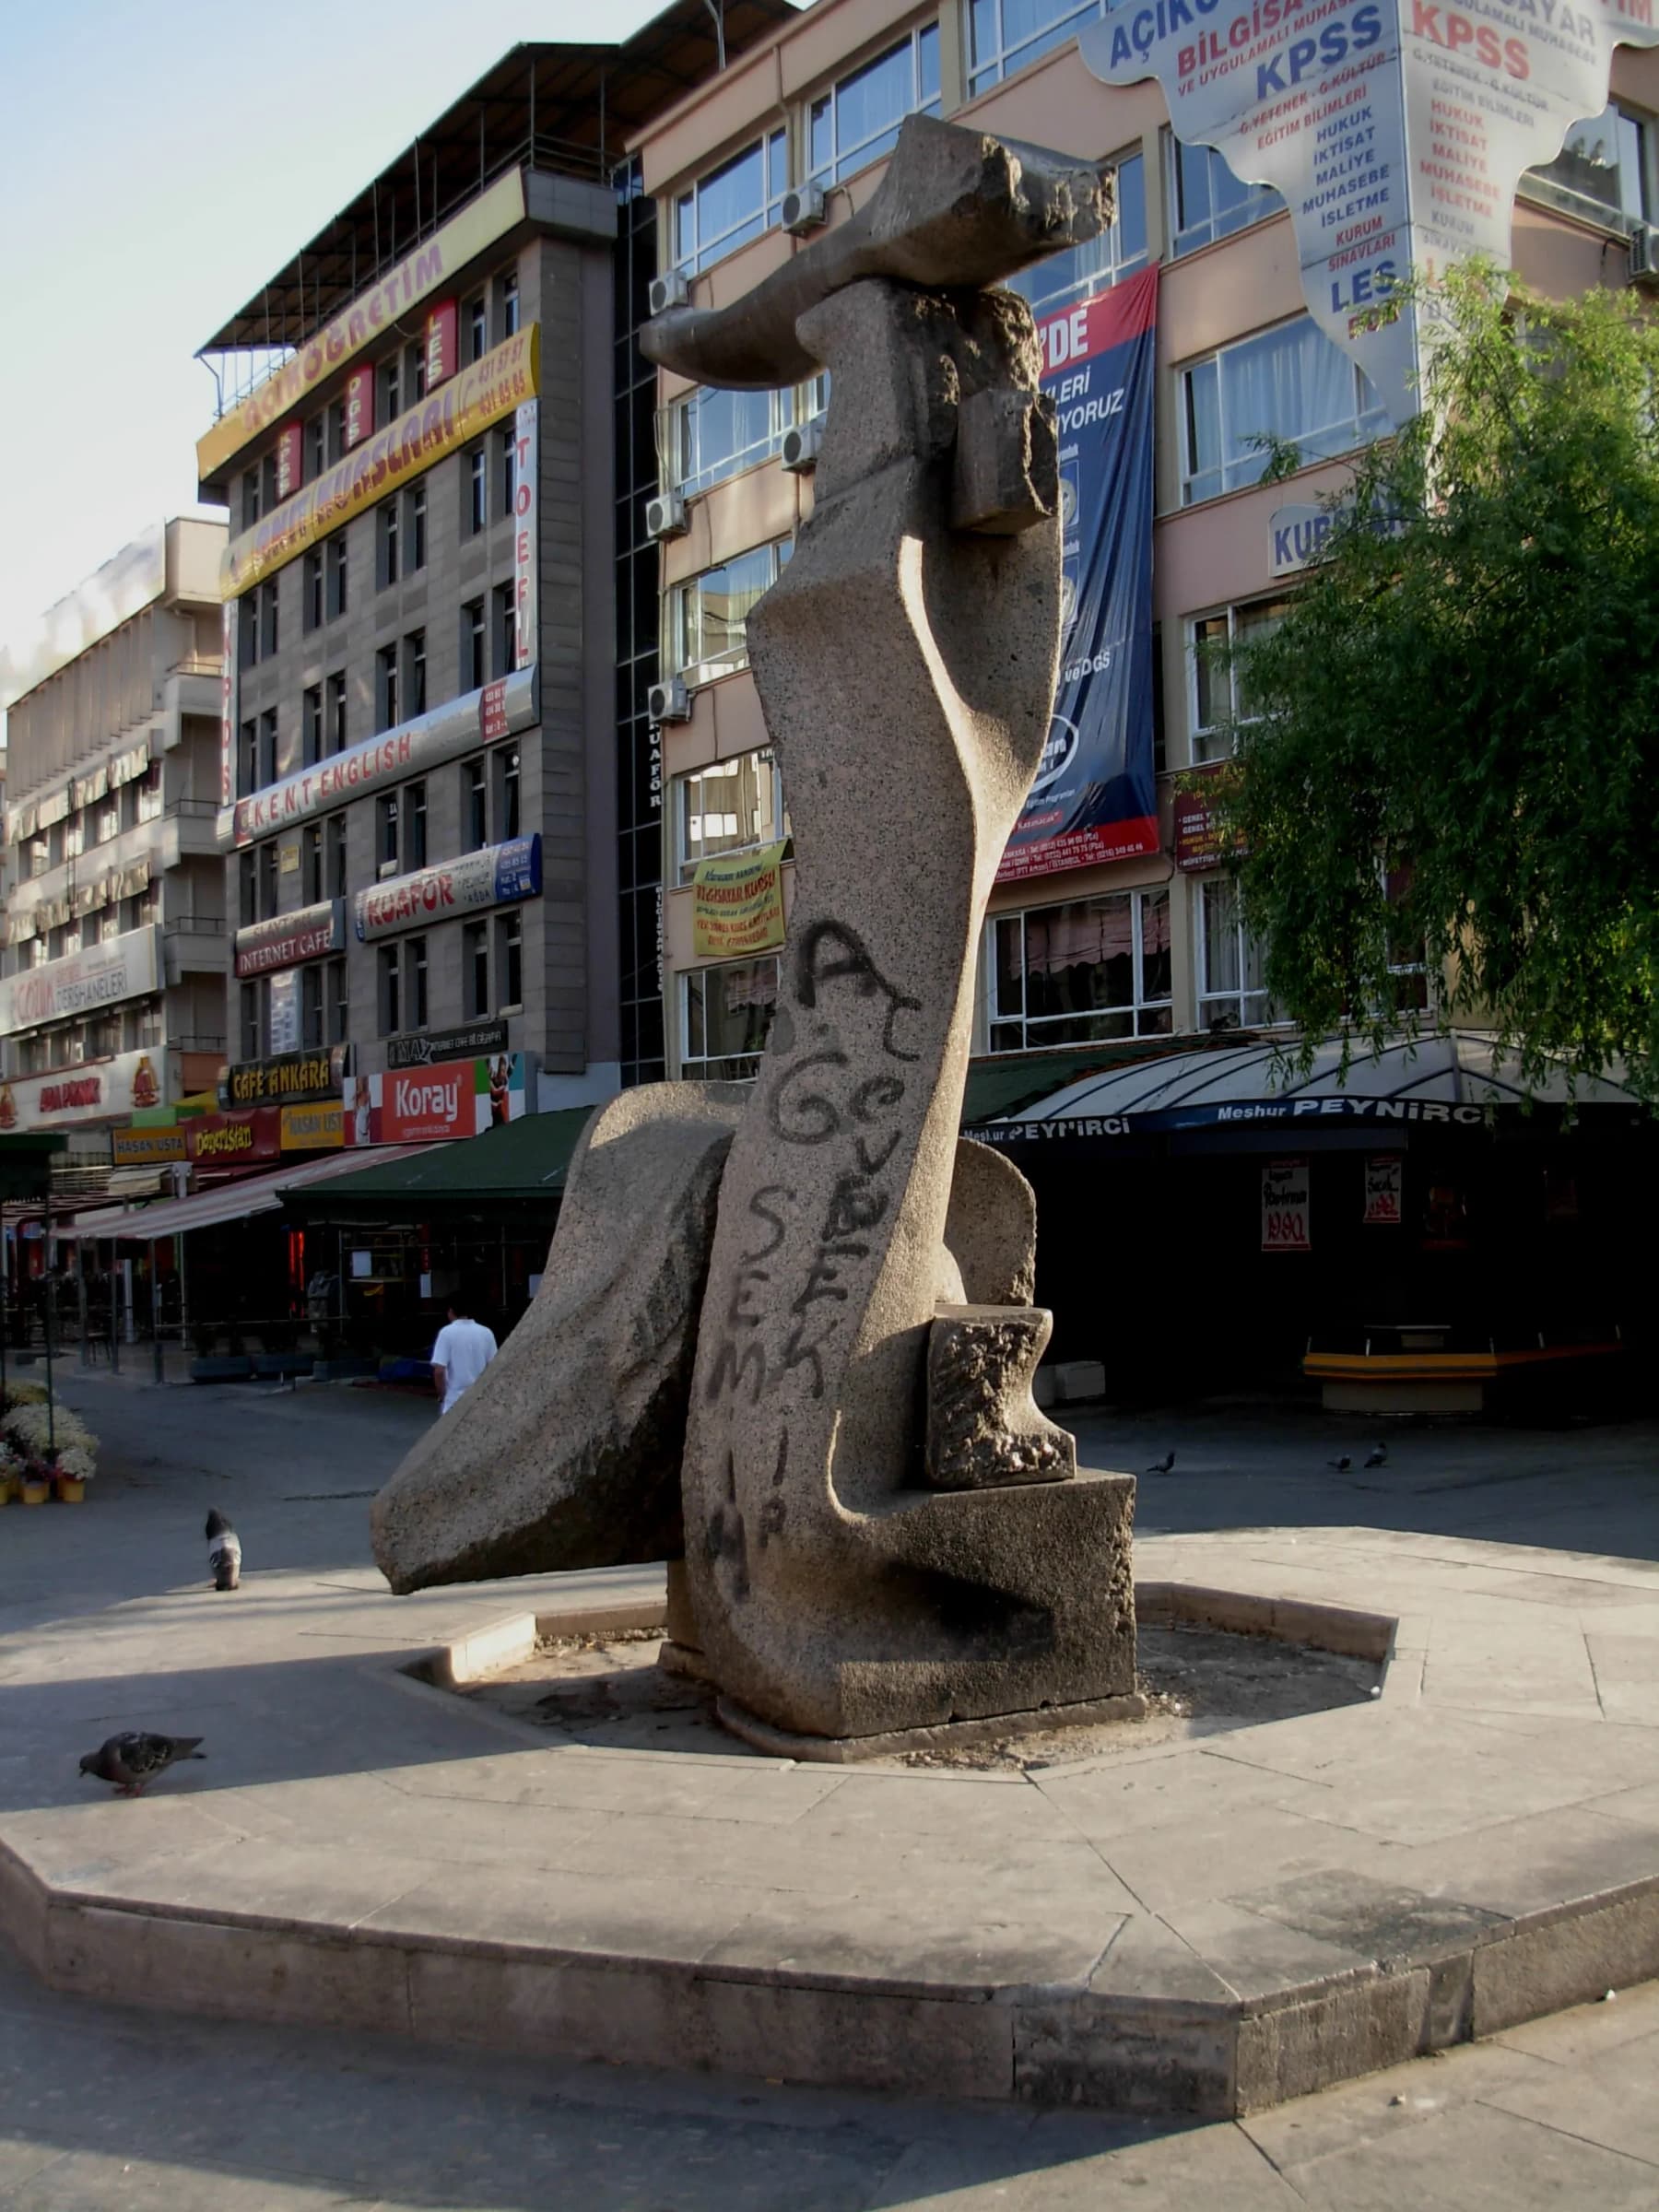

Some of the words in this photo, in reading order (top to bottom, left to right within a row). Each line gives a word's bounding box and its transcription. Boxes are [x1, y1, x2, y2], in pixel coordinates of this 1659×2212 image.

[1177, 0, 1311, 77] BİLGİSA
[1413, 0, 1530, 80] KPSS
[1503, 0, 1595, 46] AYAR
[1179, 79, 1195, 97] VE
[1199, 25, 1288, 86] UYGULAMALI
[1257, 6, 1382, 100] KPSS
[1316, 105, 1372, 143] HUKUK
[1431, 99, 1484, 130] HUKUK
[1316, 148, 1375, 186] MALİYE
[1420, 159, 1500, 201] MUHASEBE
[1302, 164, 1390, 215] MUHASEBE
[1336, 216, 1382, 246] KURUM
[1328, 234, 1395, 272] SINAVLARI
[1332, 261, 1397, 313] LES
[517, 437, 531, 658] TOEFL
[253, 777, 313, 827] KENT
[321, 733, 414, 798] ENGLISH
[240, 938, 296, 972] INTERNET
[299, 928, 331, 955] CAFE
[234, 1070, 264, 1100] CAFE
[268, 1058, 329, 1095] ANKARA
[396, 1079, 458, 1122] Koray
[324, 1111, 344, 1133] UST
[1218, 1104, 1286, 1121] Meshur
[118, 1138, 151, 1154] HASAN
[158, 1136, 182, 1151] USTA
